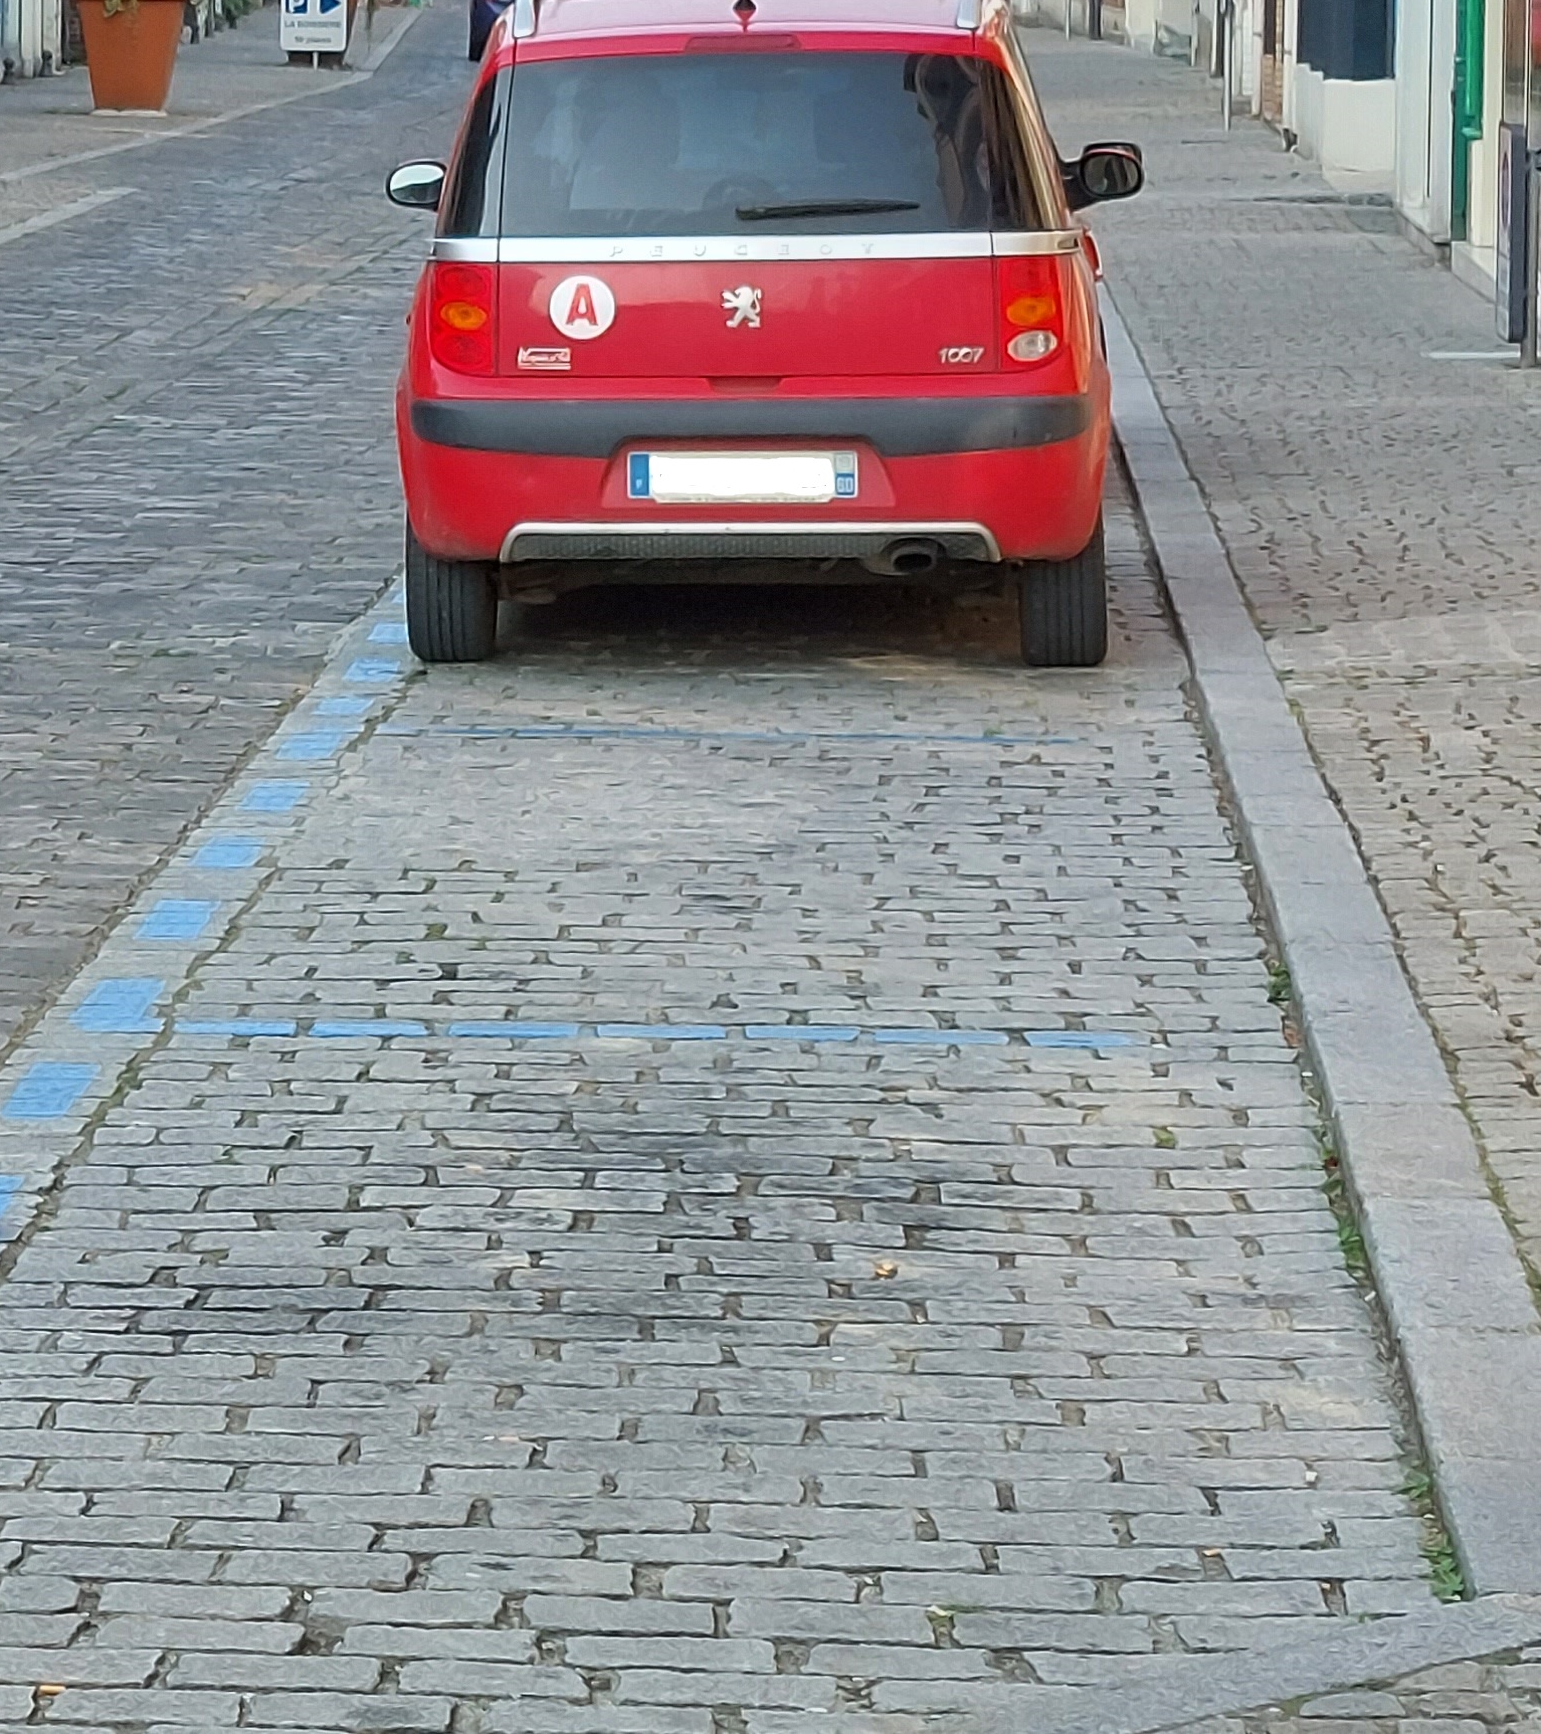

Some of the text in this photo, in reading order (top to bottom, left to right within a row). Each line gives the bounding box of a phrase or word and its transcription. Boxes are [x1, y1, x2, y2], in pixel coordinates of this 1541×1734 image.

[609, 243, 875, 258] PEUGEOT
[565, 283, 600, 327] A
[938, 346, 985, 364] 1007
